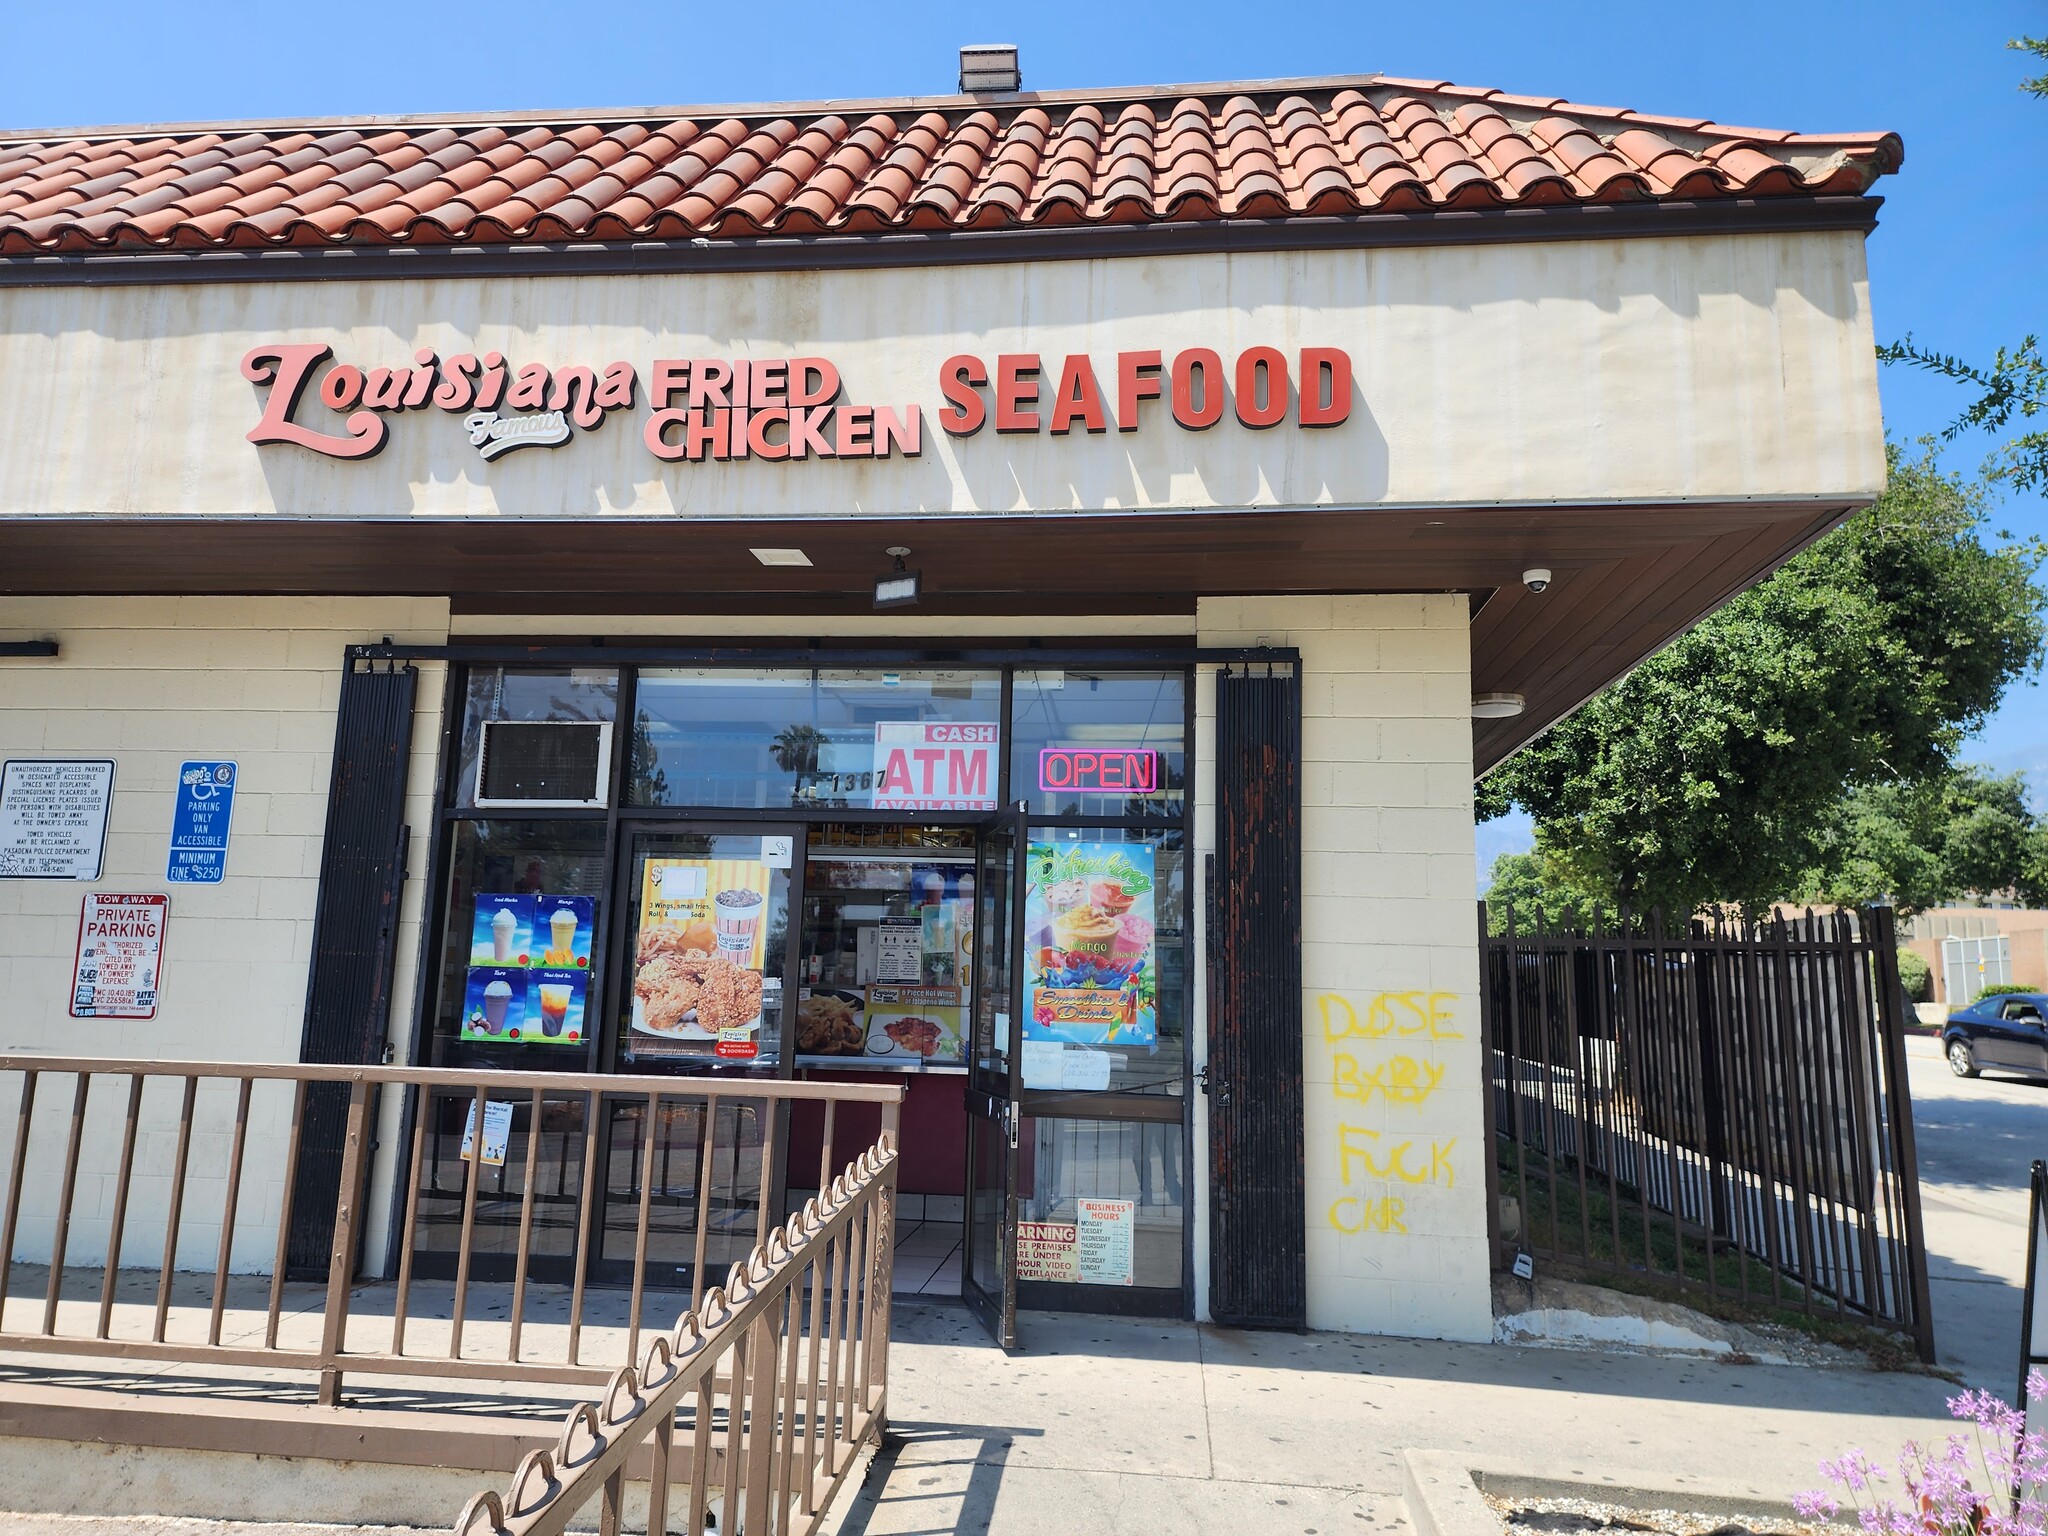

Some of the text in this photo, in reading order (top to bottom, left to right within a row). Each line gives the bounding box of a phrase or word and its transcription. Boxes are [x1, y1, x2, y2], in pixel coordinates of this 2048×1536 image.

[938, 345, 1353, 436] SEAFOOD
[240, 342, 842, 460] Louisiana FRIED
[463, 410, 568, 446] Famous
[645, 402, 923, 461] CHICKEN
[932, 726, 994, 742] CASH
[878, 748, 988, 796] ATM
[1045, 753, 1151, 788] OPEN
[832, 769, 886, 793] 1367
[188, 802, 220, 812] PARKING
[876, 800, 995, 811] AVAILABLE
[192, 813, 213, 823] ONLY
[194, 825, 208, 834] VAN
[177, 835, 222, 845] ACCESSIBLE
[179, 852, 216, 864] MINIMUM
[170, 866, 220, 879] FINE $250
[650, 865, 662, 887] $
[1028, 848, 1153, 896] Refreshing
[98, 895, 120, 903] TOW
[649, 902, 653, 910] 3
[655, 902, 676, 910] Wings,
[695, 902, 711, 910] fries,
[97, 908, 151, 921] PRIVATE
[87, 922, 156, 938] PARKING
[1070, 940, 1107, 953] Mango
[907, 989, 924, 997] Piece
[925, 989, 936, 997] Hot
[937, 989, 956, 997] Wings
[1037, 990, 1115, 1006] Smoothies
[1057, 1005, 1116, 1020] Drinks
[1338, 1122, 1458, 1189] FUCK
[1086, 1203, 1126, 1212] BUSINESS
[1091, 1212, 1120, 1221] HOURS
[1017, 1225, 1075, 1241] ARNING
[1031, 1243, 1072, 1252] PREMISES
[1033, 1251, 1062, 1260] UNDER
[1017, 1260, 1072, 1270] HOUR VIDEO
[1017, 1268, 1067, 1279] RVEILLANCE
